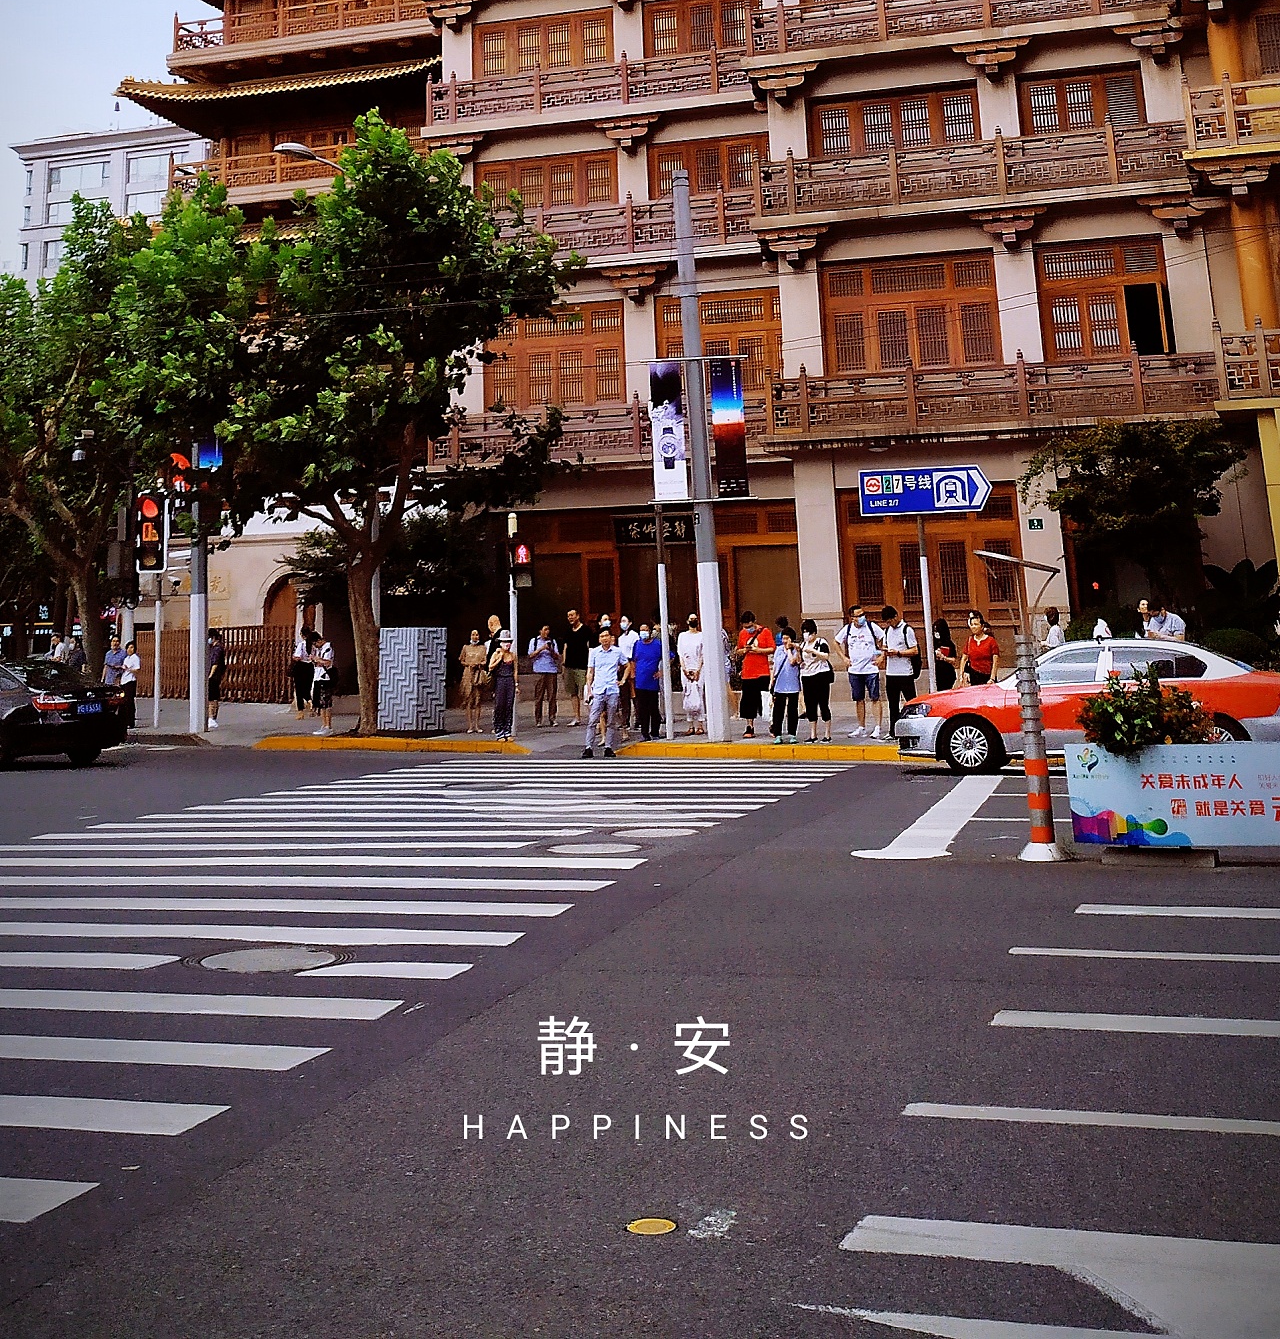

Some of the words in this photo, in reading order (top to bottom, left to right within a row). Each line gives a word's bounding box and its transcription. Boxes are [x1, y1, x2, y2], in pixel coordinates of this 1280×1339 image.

[870, 499, 888, 508] LINE
[889, 499, 899, 507] 2/7
[1140, 773, 1244, 790] 关爱未成年人
